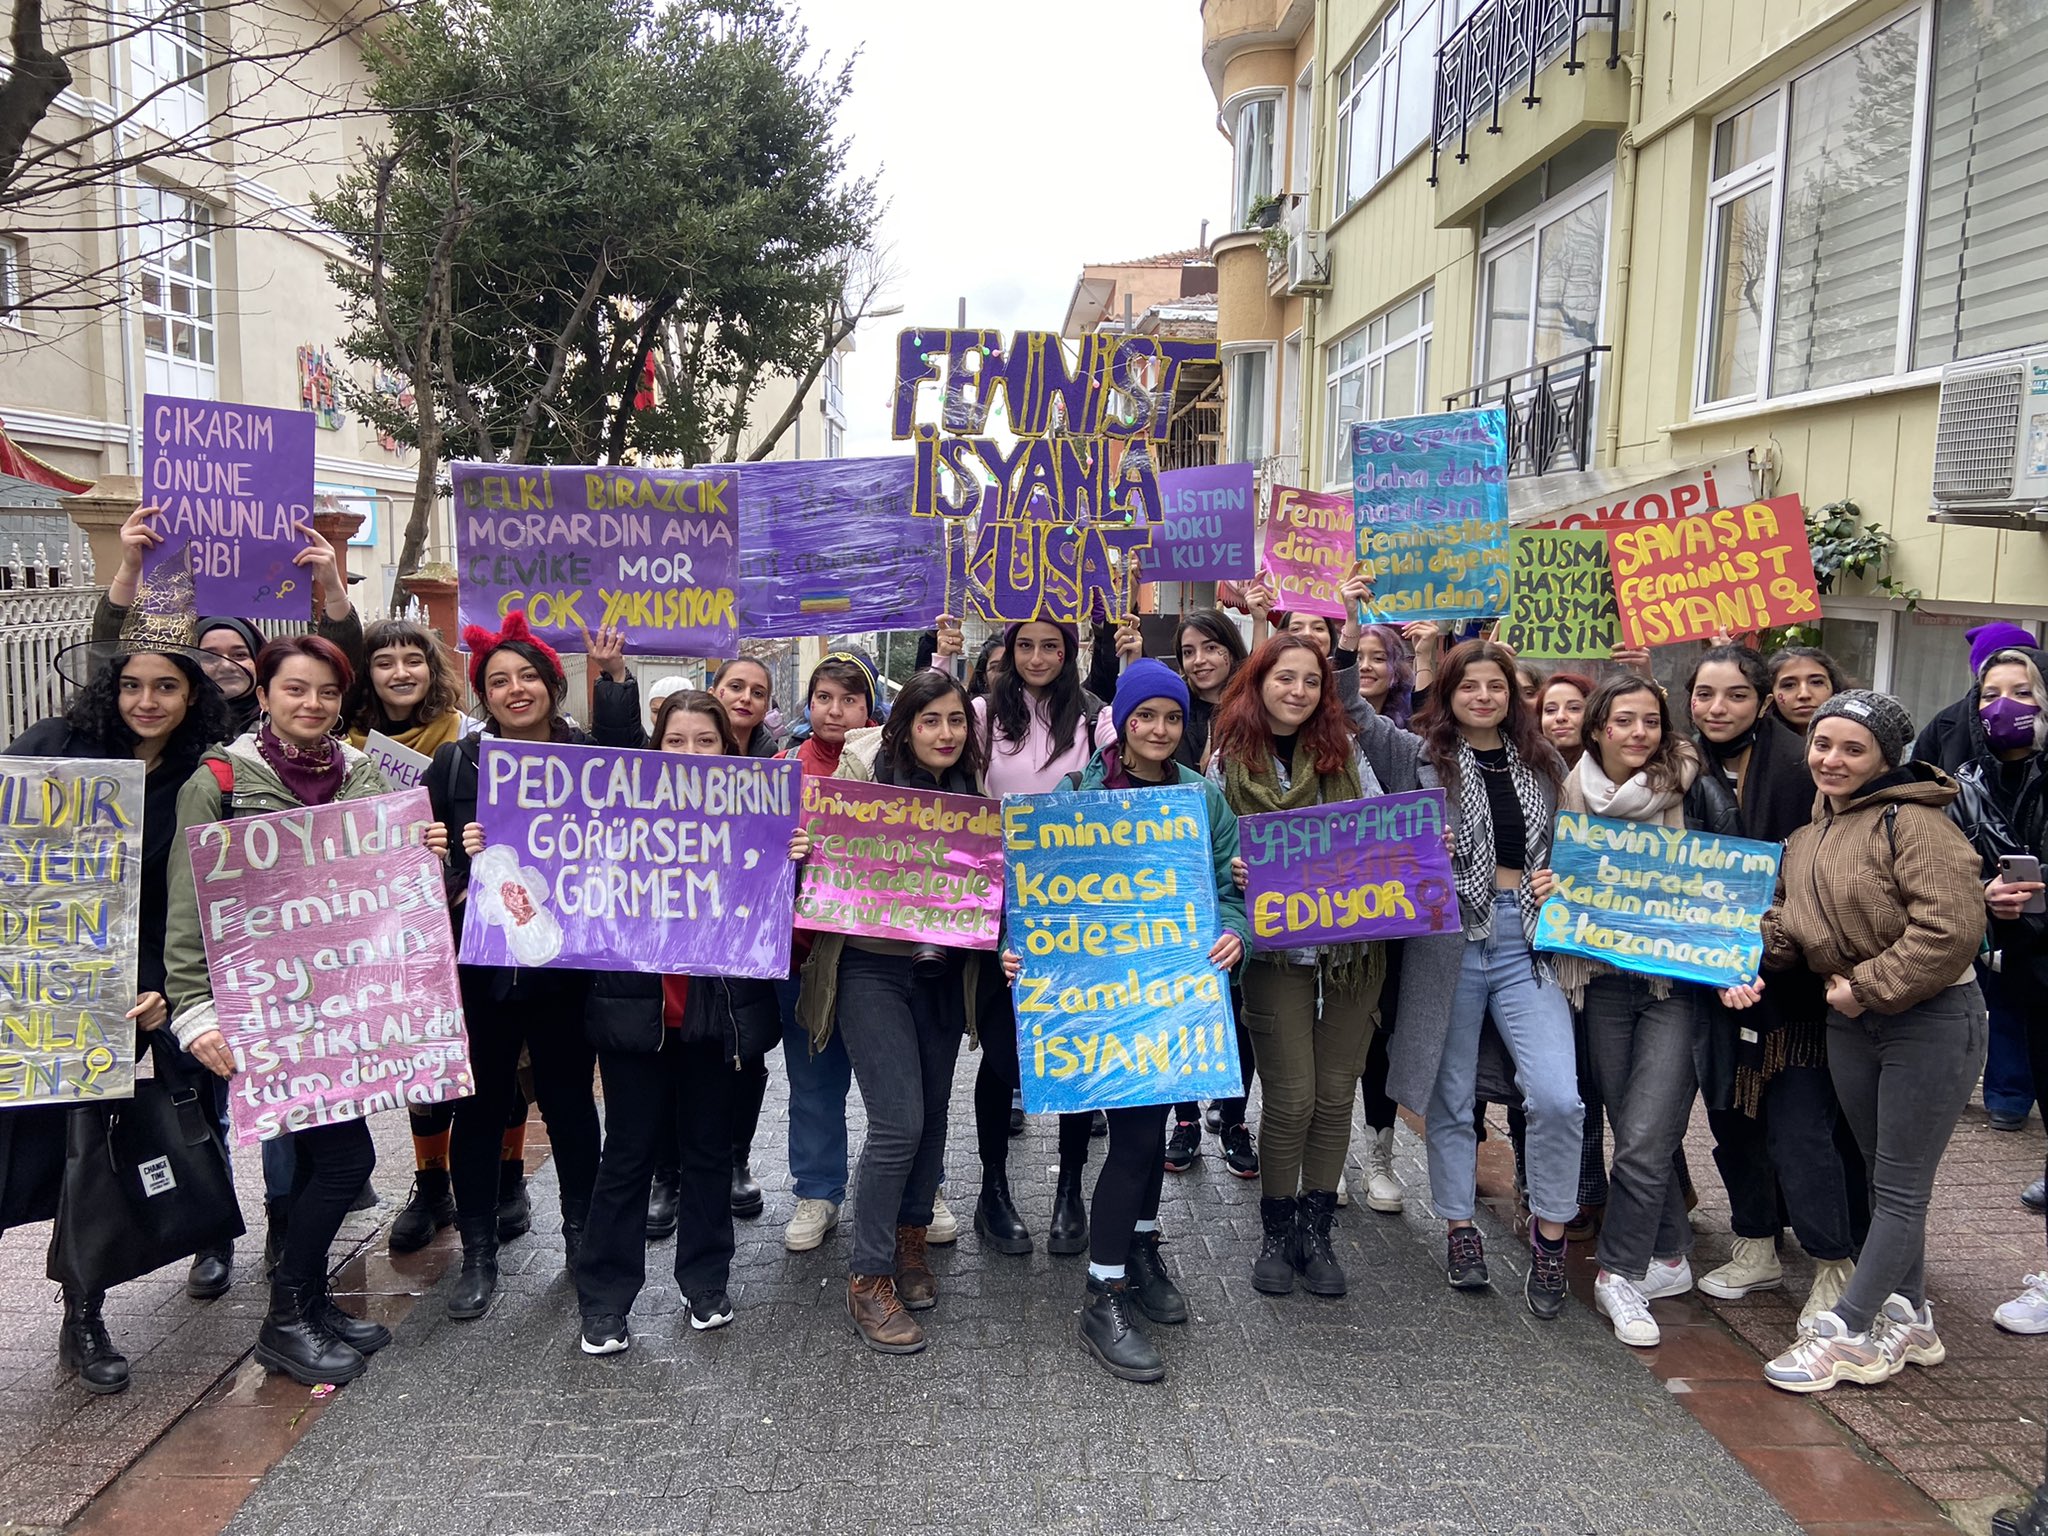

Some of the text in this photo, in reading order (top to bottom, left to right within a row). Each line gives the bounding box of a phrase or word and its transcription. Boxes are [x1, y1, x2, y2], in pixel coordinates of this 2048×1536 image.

[154, 405, 273, 452] ÇIKARIM
[153, 449, 254, 496] ÖNÜNE
[463, 469, 553, 511] BELKİ
[585, 472, 729, 515] BİRAZCIK
[911, 422, 1165, 525] İSYANLA
[1354, 457, 1505, 492] daha daha
[151, 495, 310, 543] KANUNLAR
[468, 513, 733, 549] MORARDIN AMA
[1163, 514, 1222, 542] DOKU
[1359, 517, 1508, 555] feministler
[185, 535, 240, 578] GİBİ
[618, 552, 696, 585] MOR
[1358, 551, 1424, 582] geldi
[1428, 547, 1479, 583] diye
[1620, 545, 1793, 607] FEMİNİST
[1512, 568, 1616, 598] HAYKIR
[598, 587, 738, 632] YAKIŞIYOR
[1514, 594, 1621, 625] SUSMA
[1625, 583, 1772, 648] İSYAN!
[1507, 619, 1616, 656] BİTSİN
[487, 749, 793, 819] PED ÇALAN BİRİNİ
[802, 778, 1002, 837] Üniversitelerde
[9, 829, 128, 886] YENİ
[200, 819, 279, 884] 20
[527, 812, 761, 870] GÖRÜRSEM,
[805, 817, 951, 867] feminist
[1557, 813, 1776, 876] Nevin Yıldırım
[801, 860, 991, 904] mücadeleyle
[1015, 861, 1177, 907] kocası
[1303, 842, 1422, 888] ISRAR
[1597, 854, 1738, 900] burada.
[210, 862, 446, 942] Feminist
[555, 864, 750, 920] GÖRMEM.
[1253, 879, 1416, 938] EDİYOR
[1551, 873, 1641, 914] Kadın
[1024, 902, 1199, 956] ödesin!
[241, 981, 403, 1037] diyarı
[1017, 969, 1221, 1014] Zamlara
[1033, 1023, 1227, 1078] İSYAN!!!
[236, 1042, 466, 1109] tüm dünyaya
[143, 1160, 168, 1175] CHANGE
[151, 1170, 165, 1181] TIME
